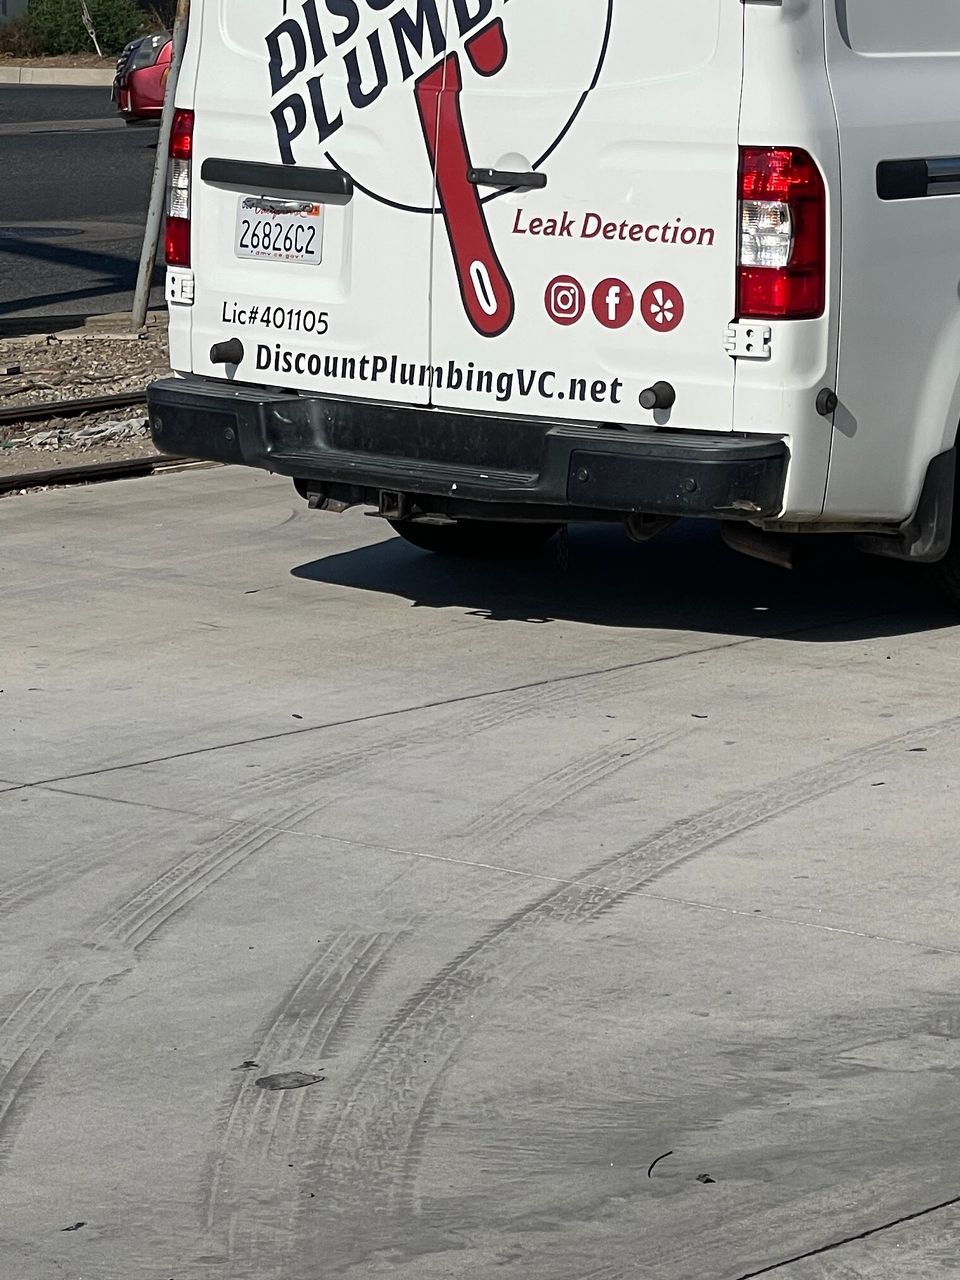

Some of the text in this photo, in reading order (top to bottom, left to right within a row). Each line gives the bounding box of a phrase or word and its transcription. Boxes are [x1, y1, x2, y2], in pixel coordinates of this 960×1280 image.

[240, 220, 316, 254] 26826C2
[512, 208, 715, 246] Leak Detection
[222, 301, 329, 335] Lic#401105
[255, 343, 623, 404] DiscountPlumbingVC.net
